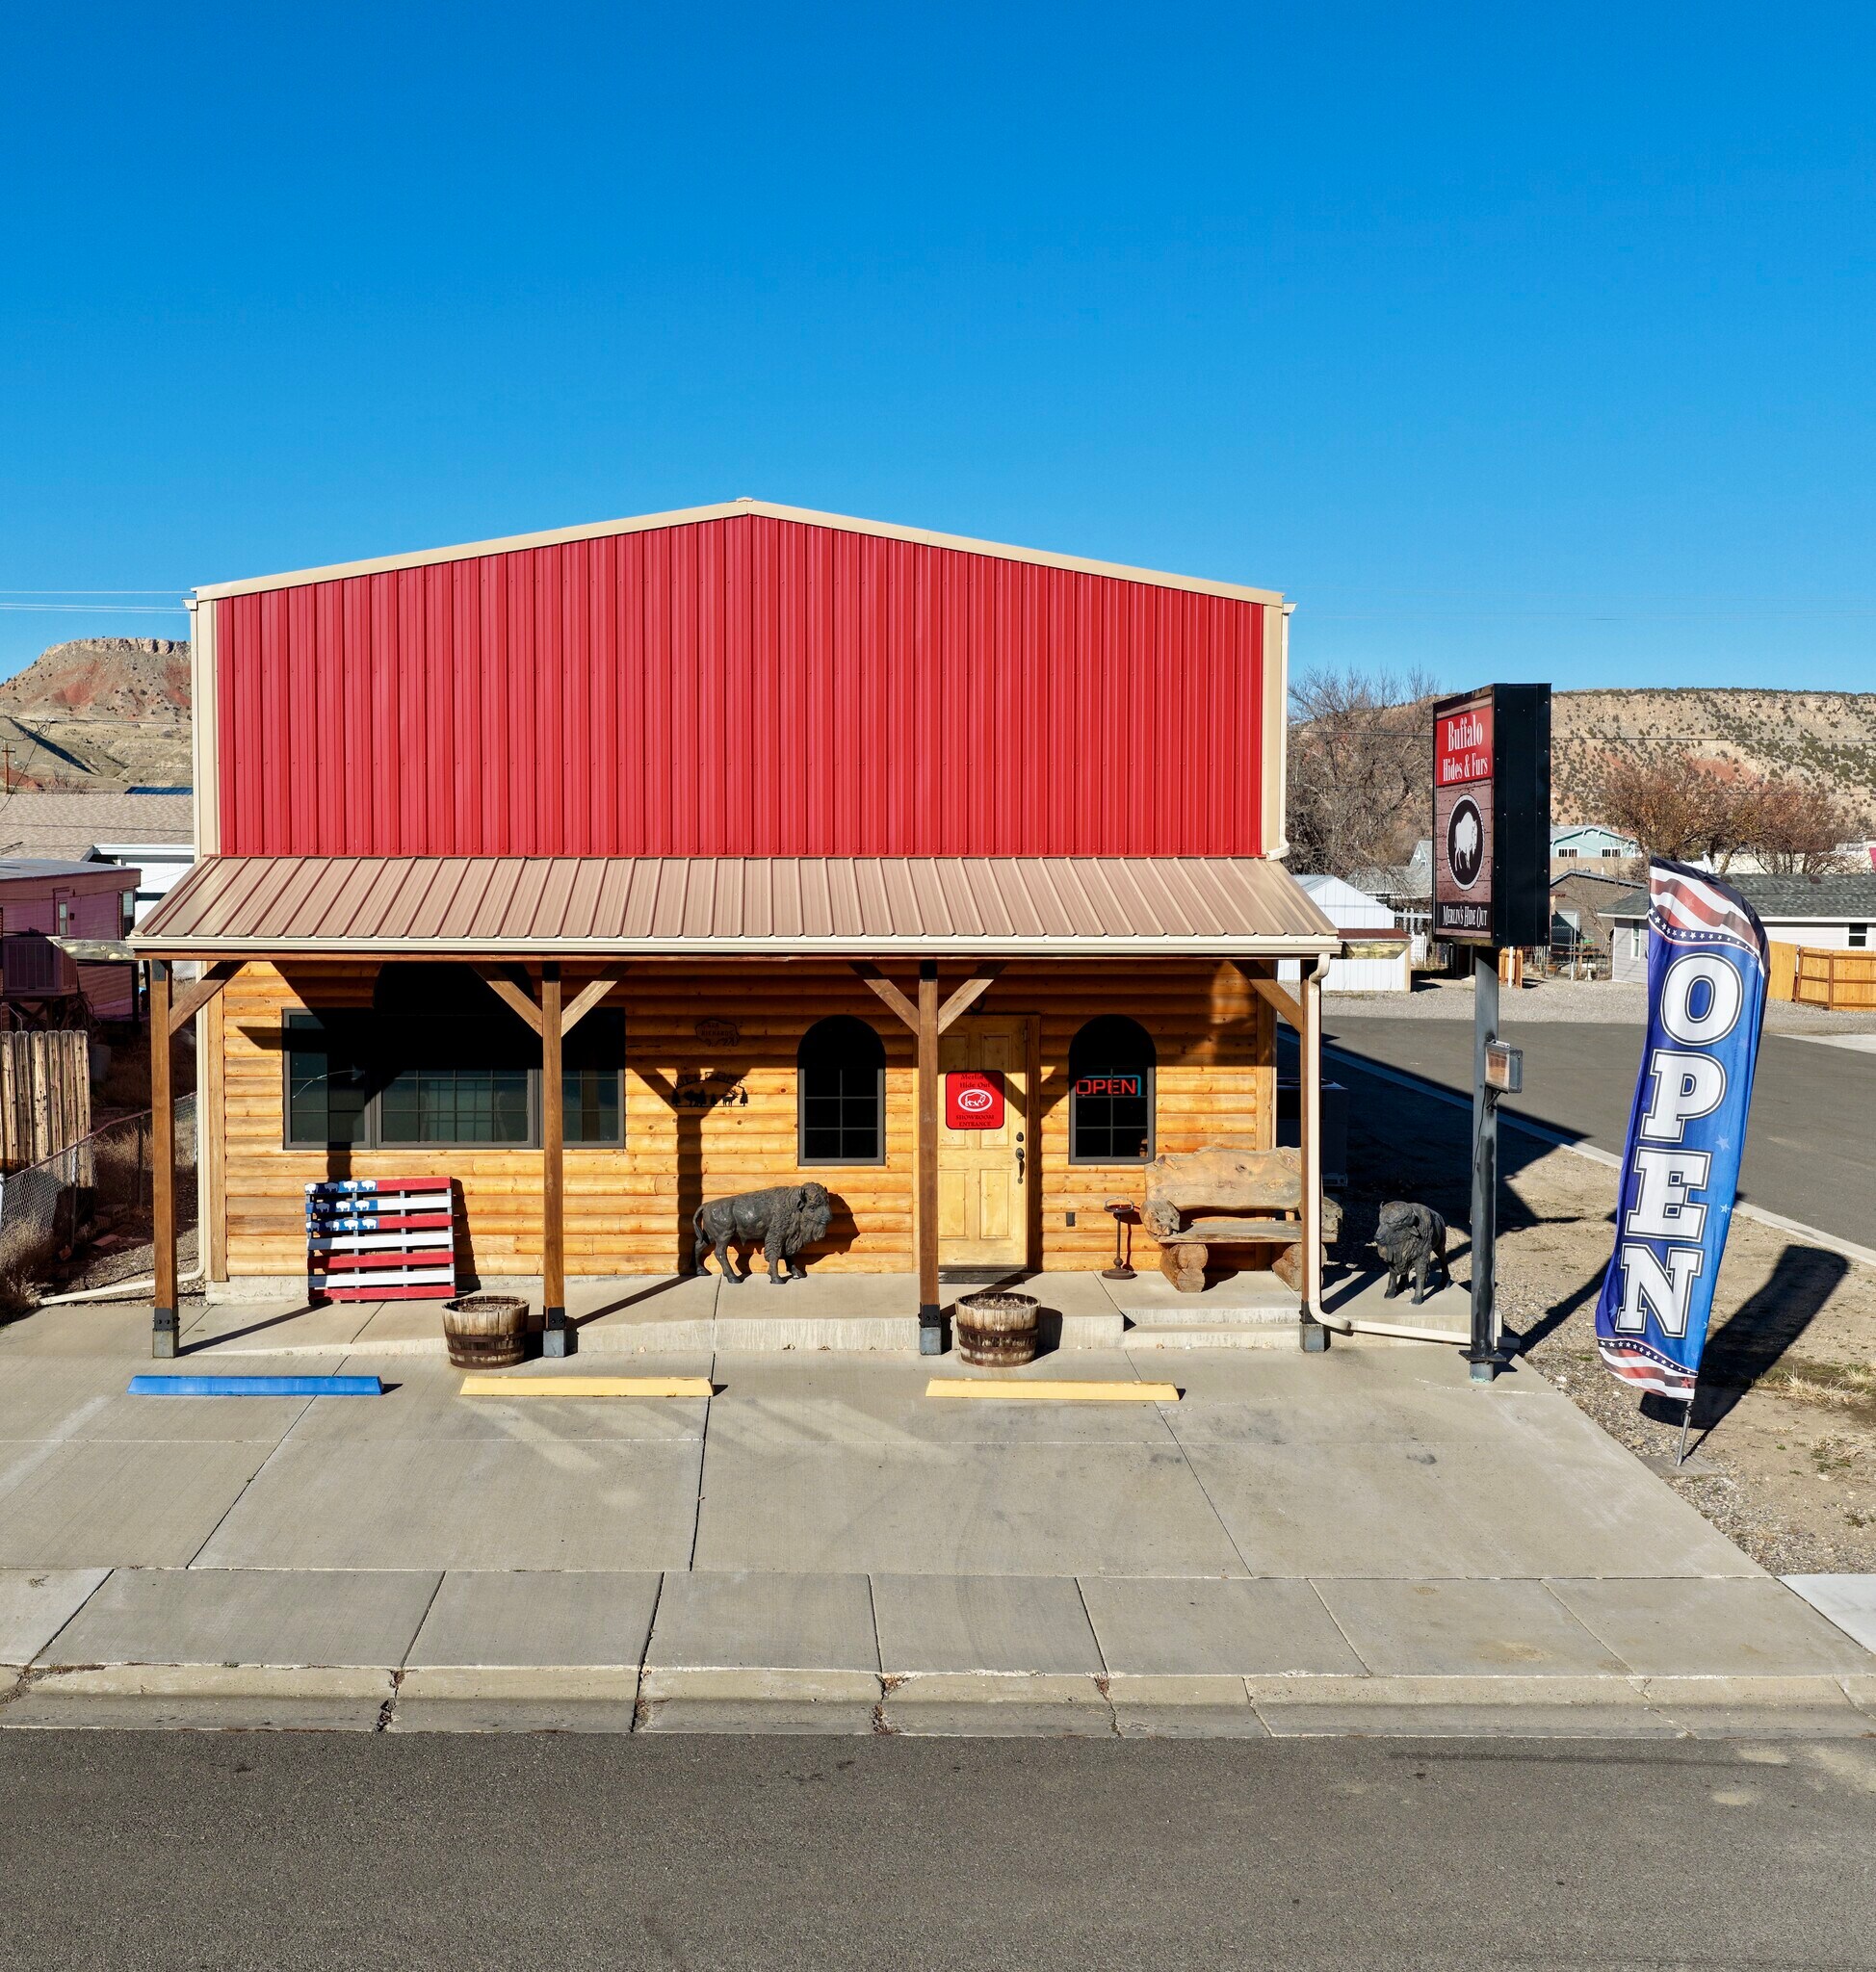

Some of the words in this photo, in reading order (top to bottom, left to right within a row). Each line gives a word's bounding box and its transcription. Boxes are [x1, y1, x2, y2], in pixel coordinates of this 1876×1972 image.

[1447, 714, 1483, 752] Buffalo
[1443, 757, 1463, 782] Hides
[1464, 754, 1471, 778] &
[1472, 752, 1488, 777] Furs
[1076, 1079, 1136, 1095] OPEN
[1615, 952, 1743, 1337] OPEN
